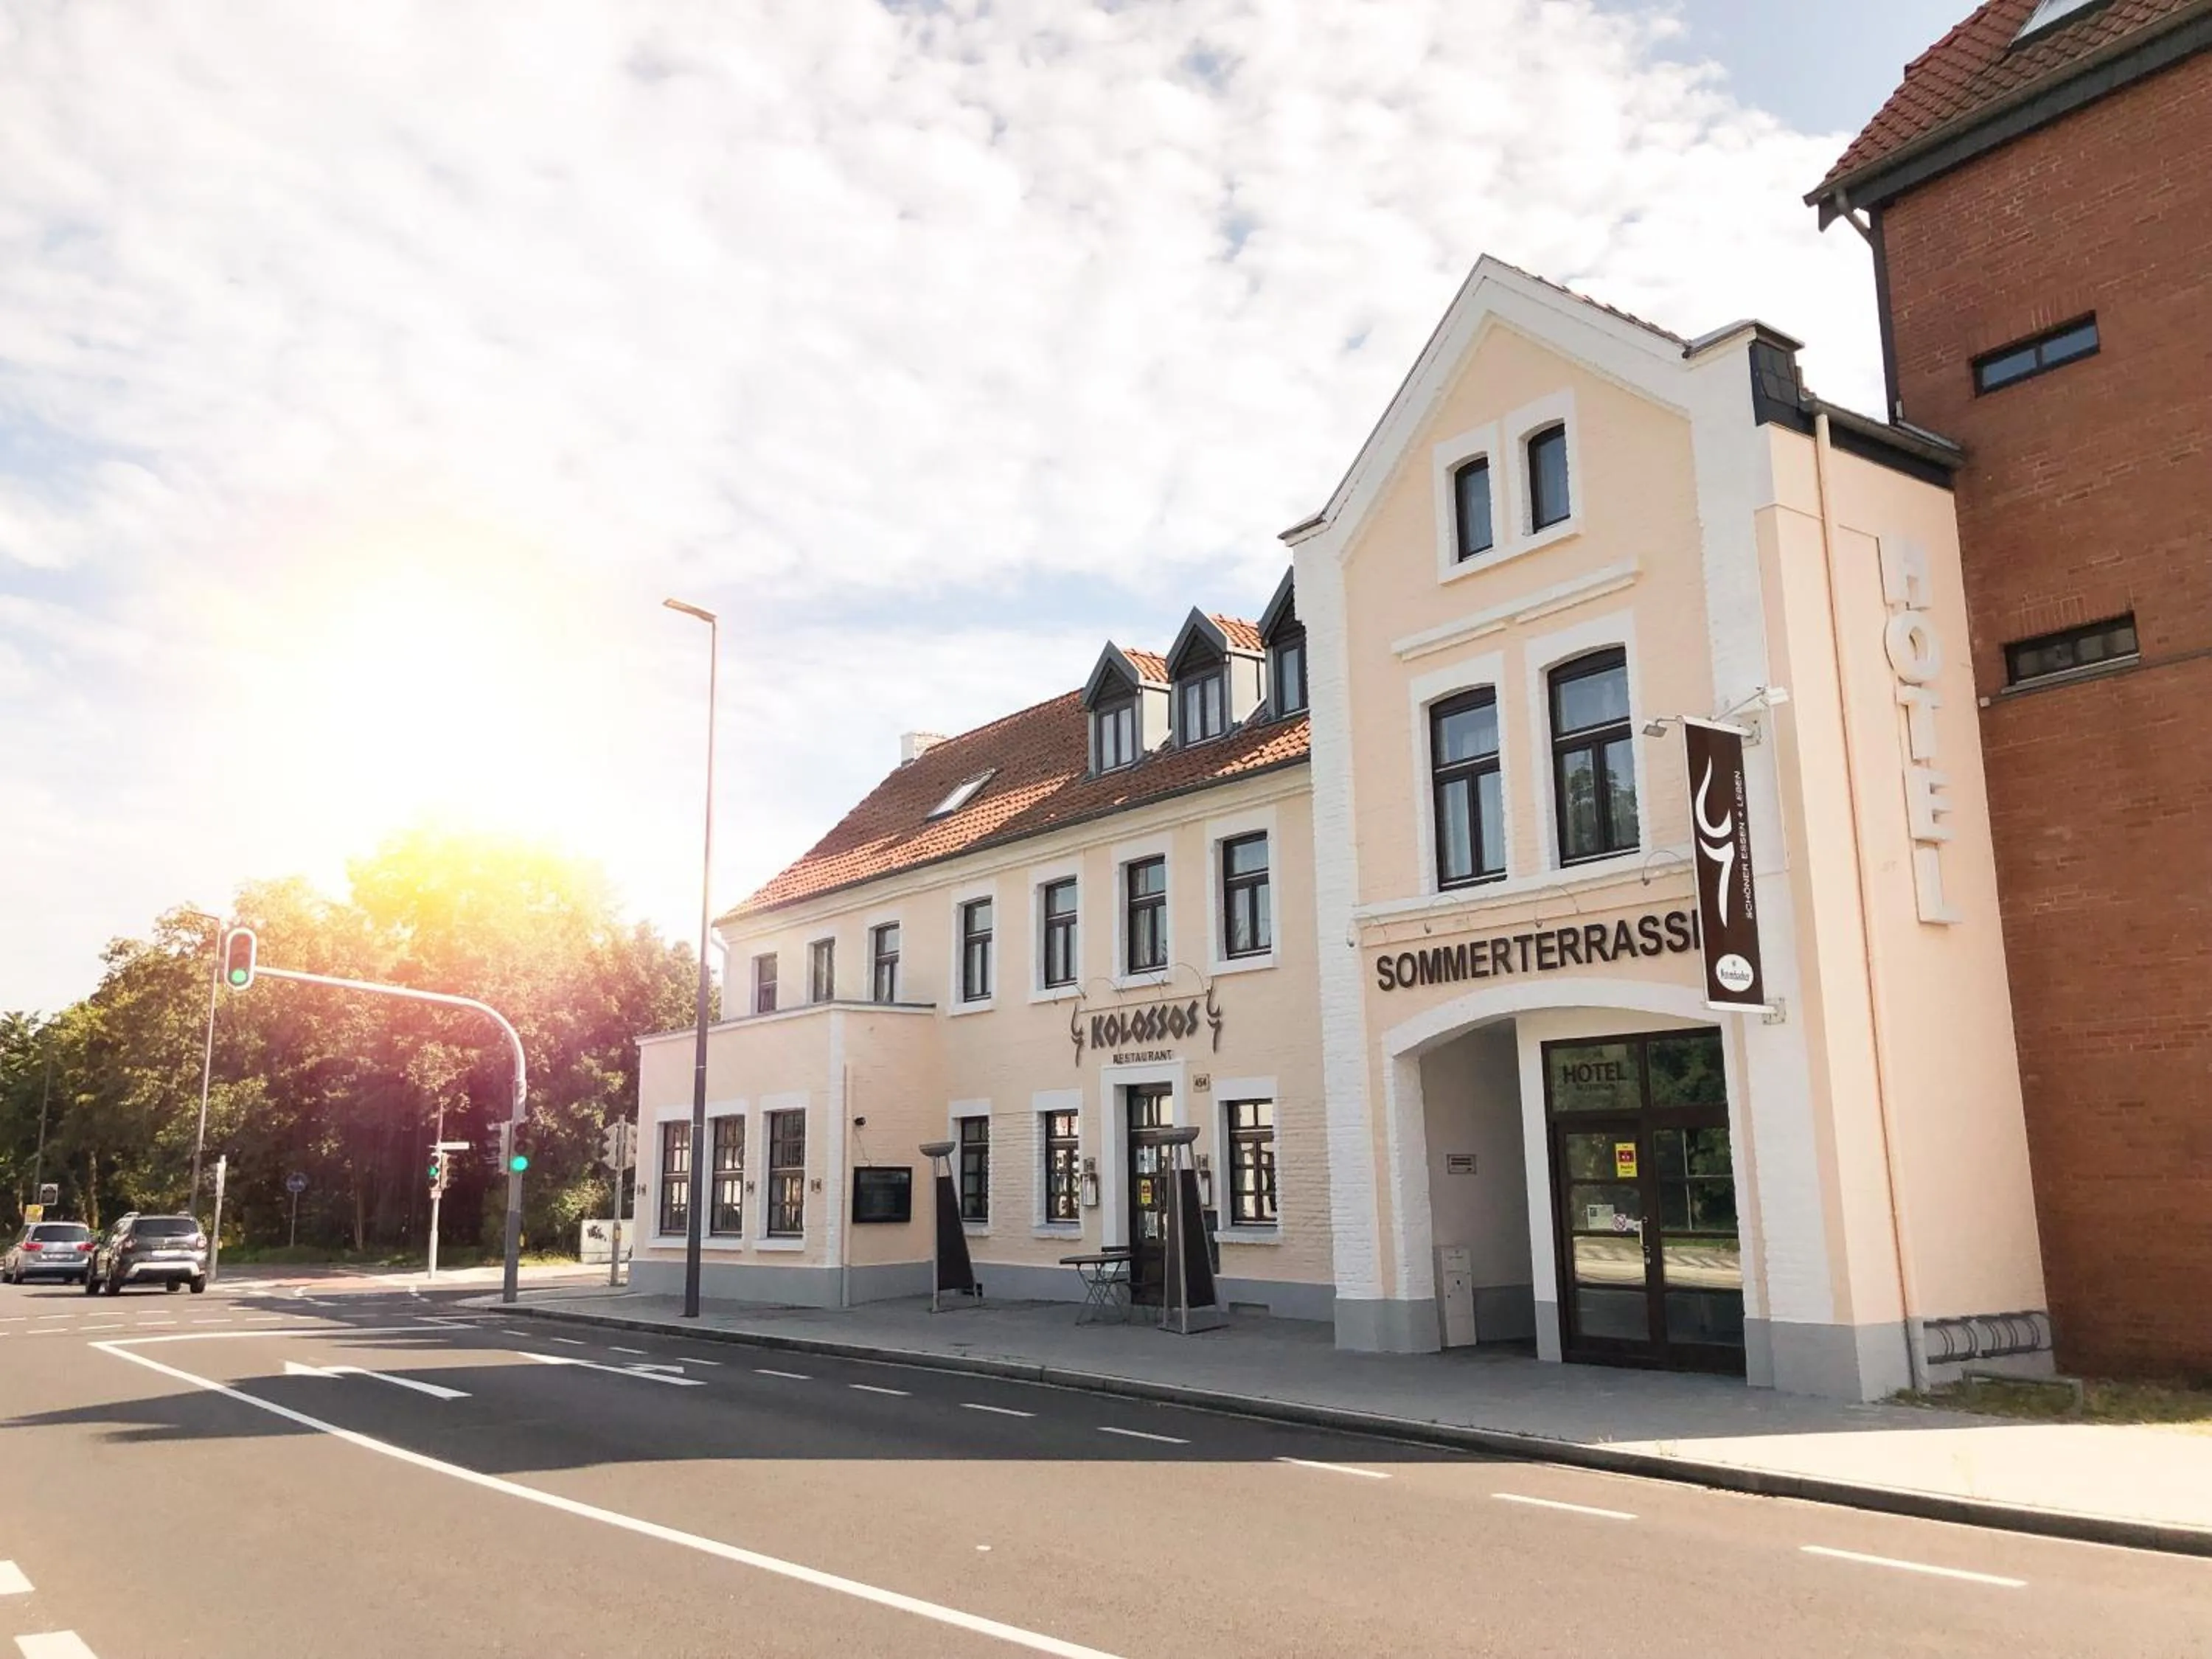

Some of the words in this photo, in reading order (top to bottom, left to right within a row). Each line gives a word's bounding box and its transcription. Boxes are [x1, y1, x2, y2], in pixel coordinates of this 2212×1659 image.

[1877, 532, 1962, 925] HOTEL
[1739, 822, 1748, 860] ESSEN
[1091, 1000, 1200, 1050] KOLOSSOS
[1113, 1049, 1173, 1065] RESTAURANT
[1563, 1060, 1627, 1084] HOTEL
